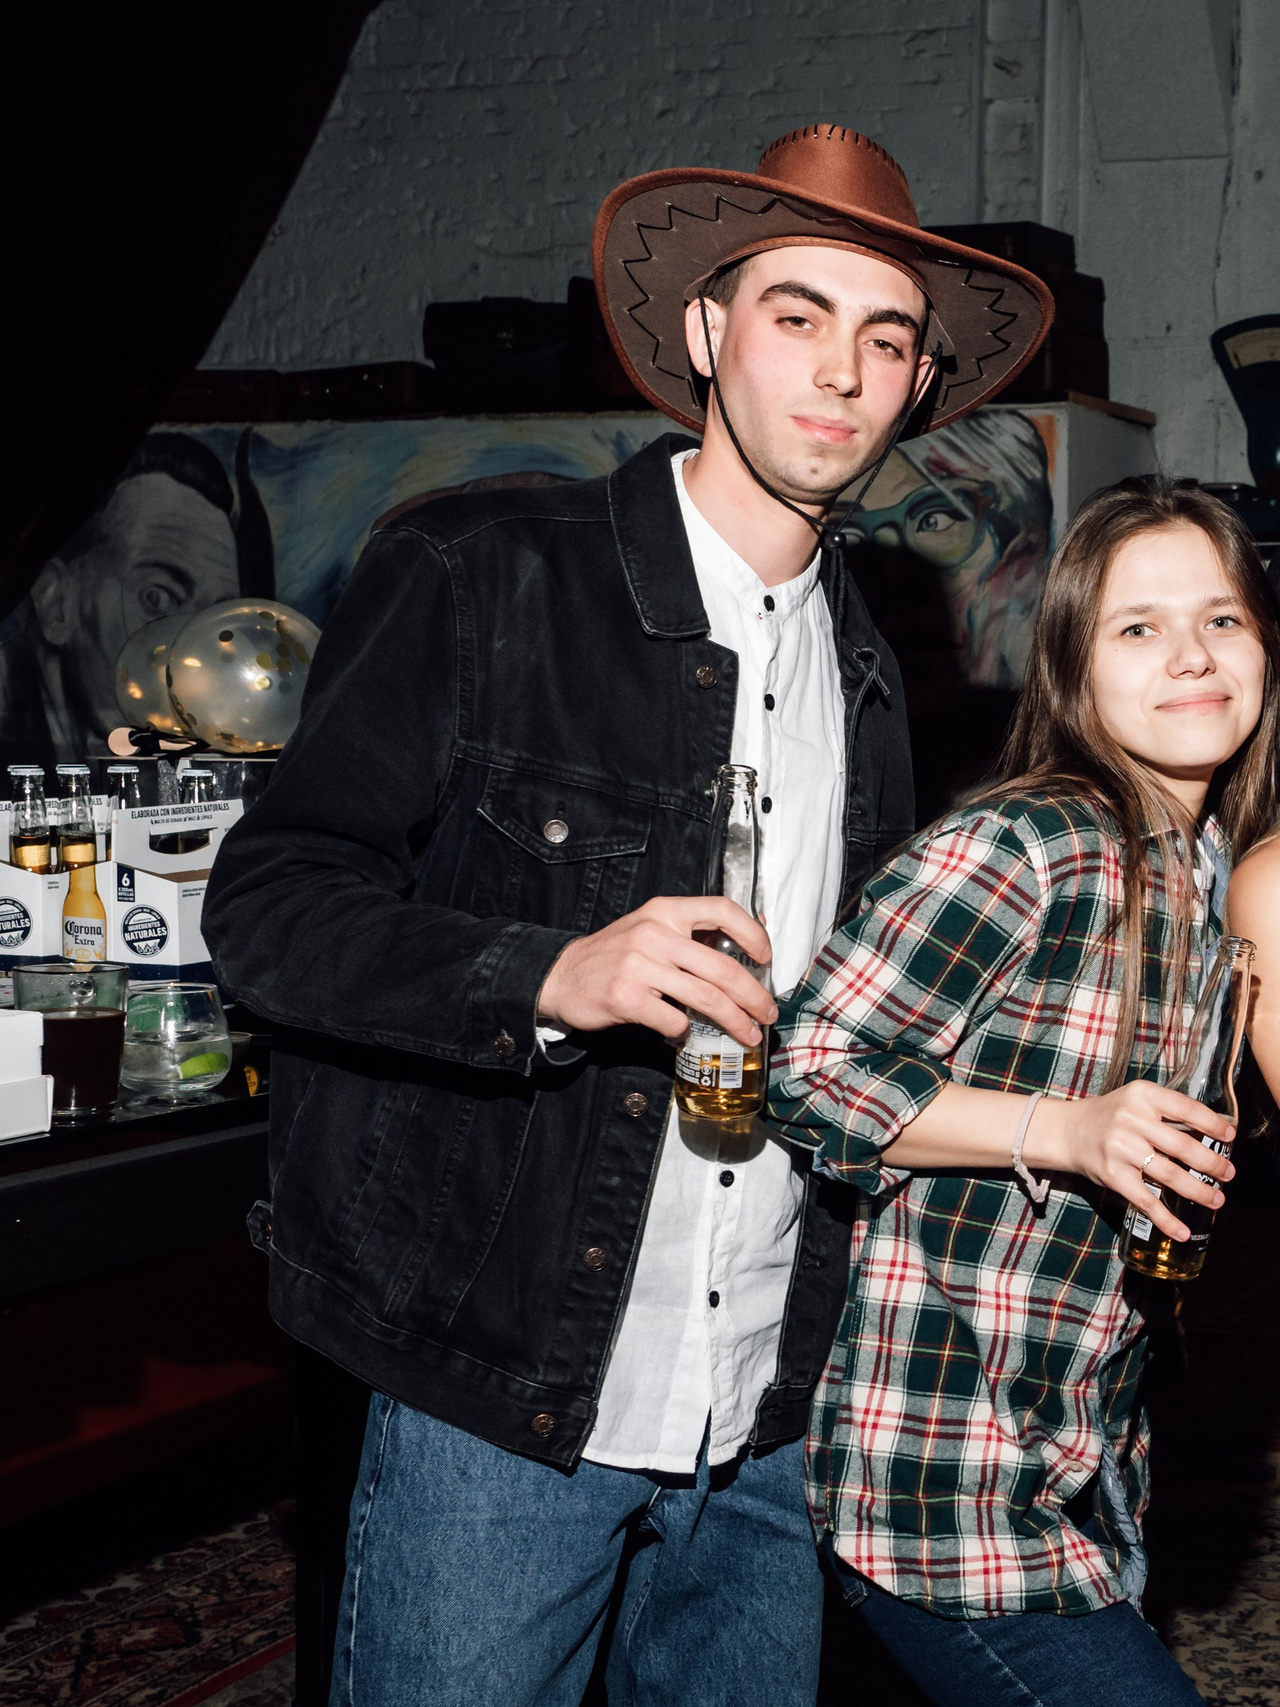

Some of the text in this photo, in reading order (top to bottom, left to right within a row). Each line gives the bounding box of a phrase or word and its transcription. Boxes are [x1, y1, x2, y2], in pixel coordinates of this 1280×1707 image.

[131, 803, 230, 819] ELABORADA CON INGREDIENTES NATURALES
[121, 873, 130, 887] 6
[0, 918, 31, 931] TURALES
[65, 920, 104, 938] Corona
[74, 935, 95, 946] Extra
[124, 926, 167, 942] NATURALES
